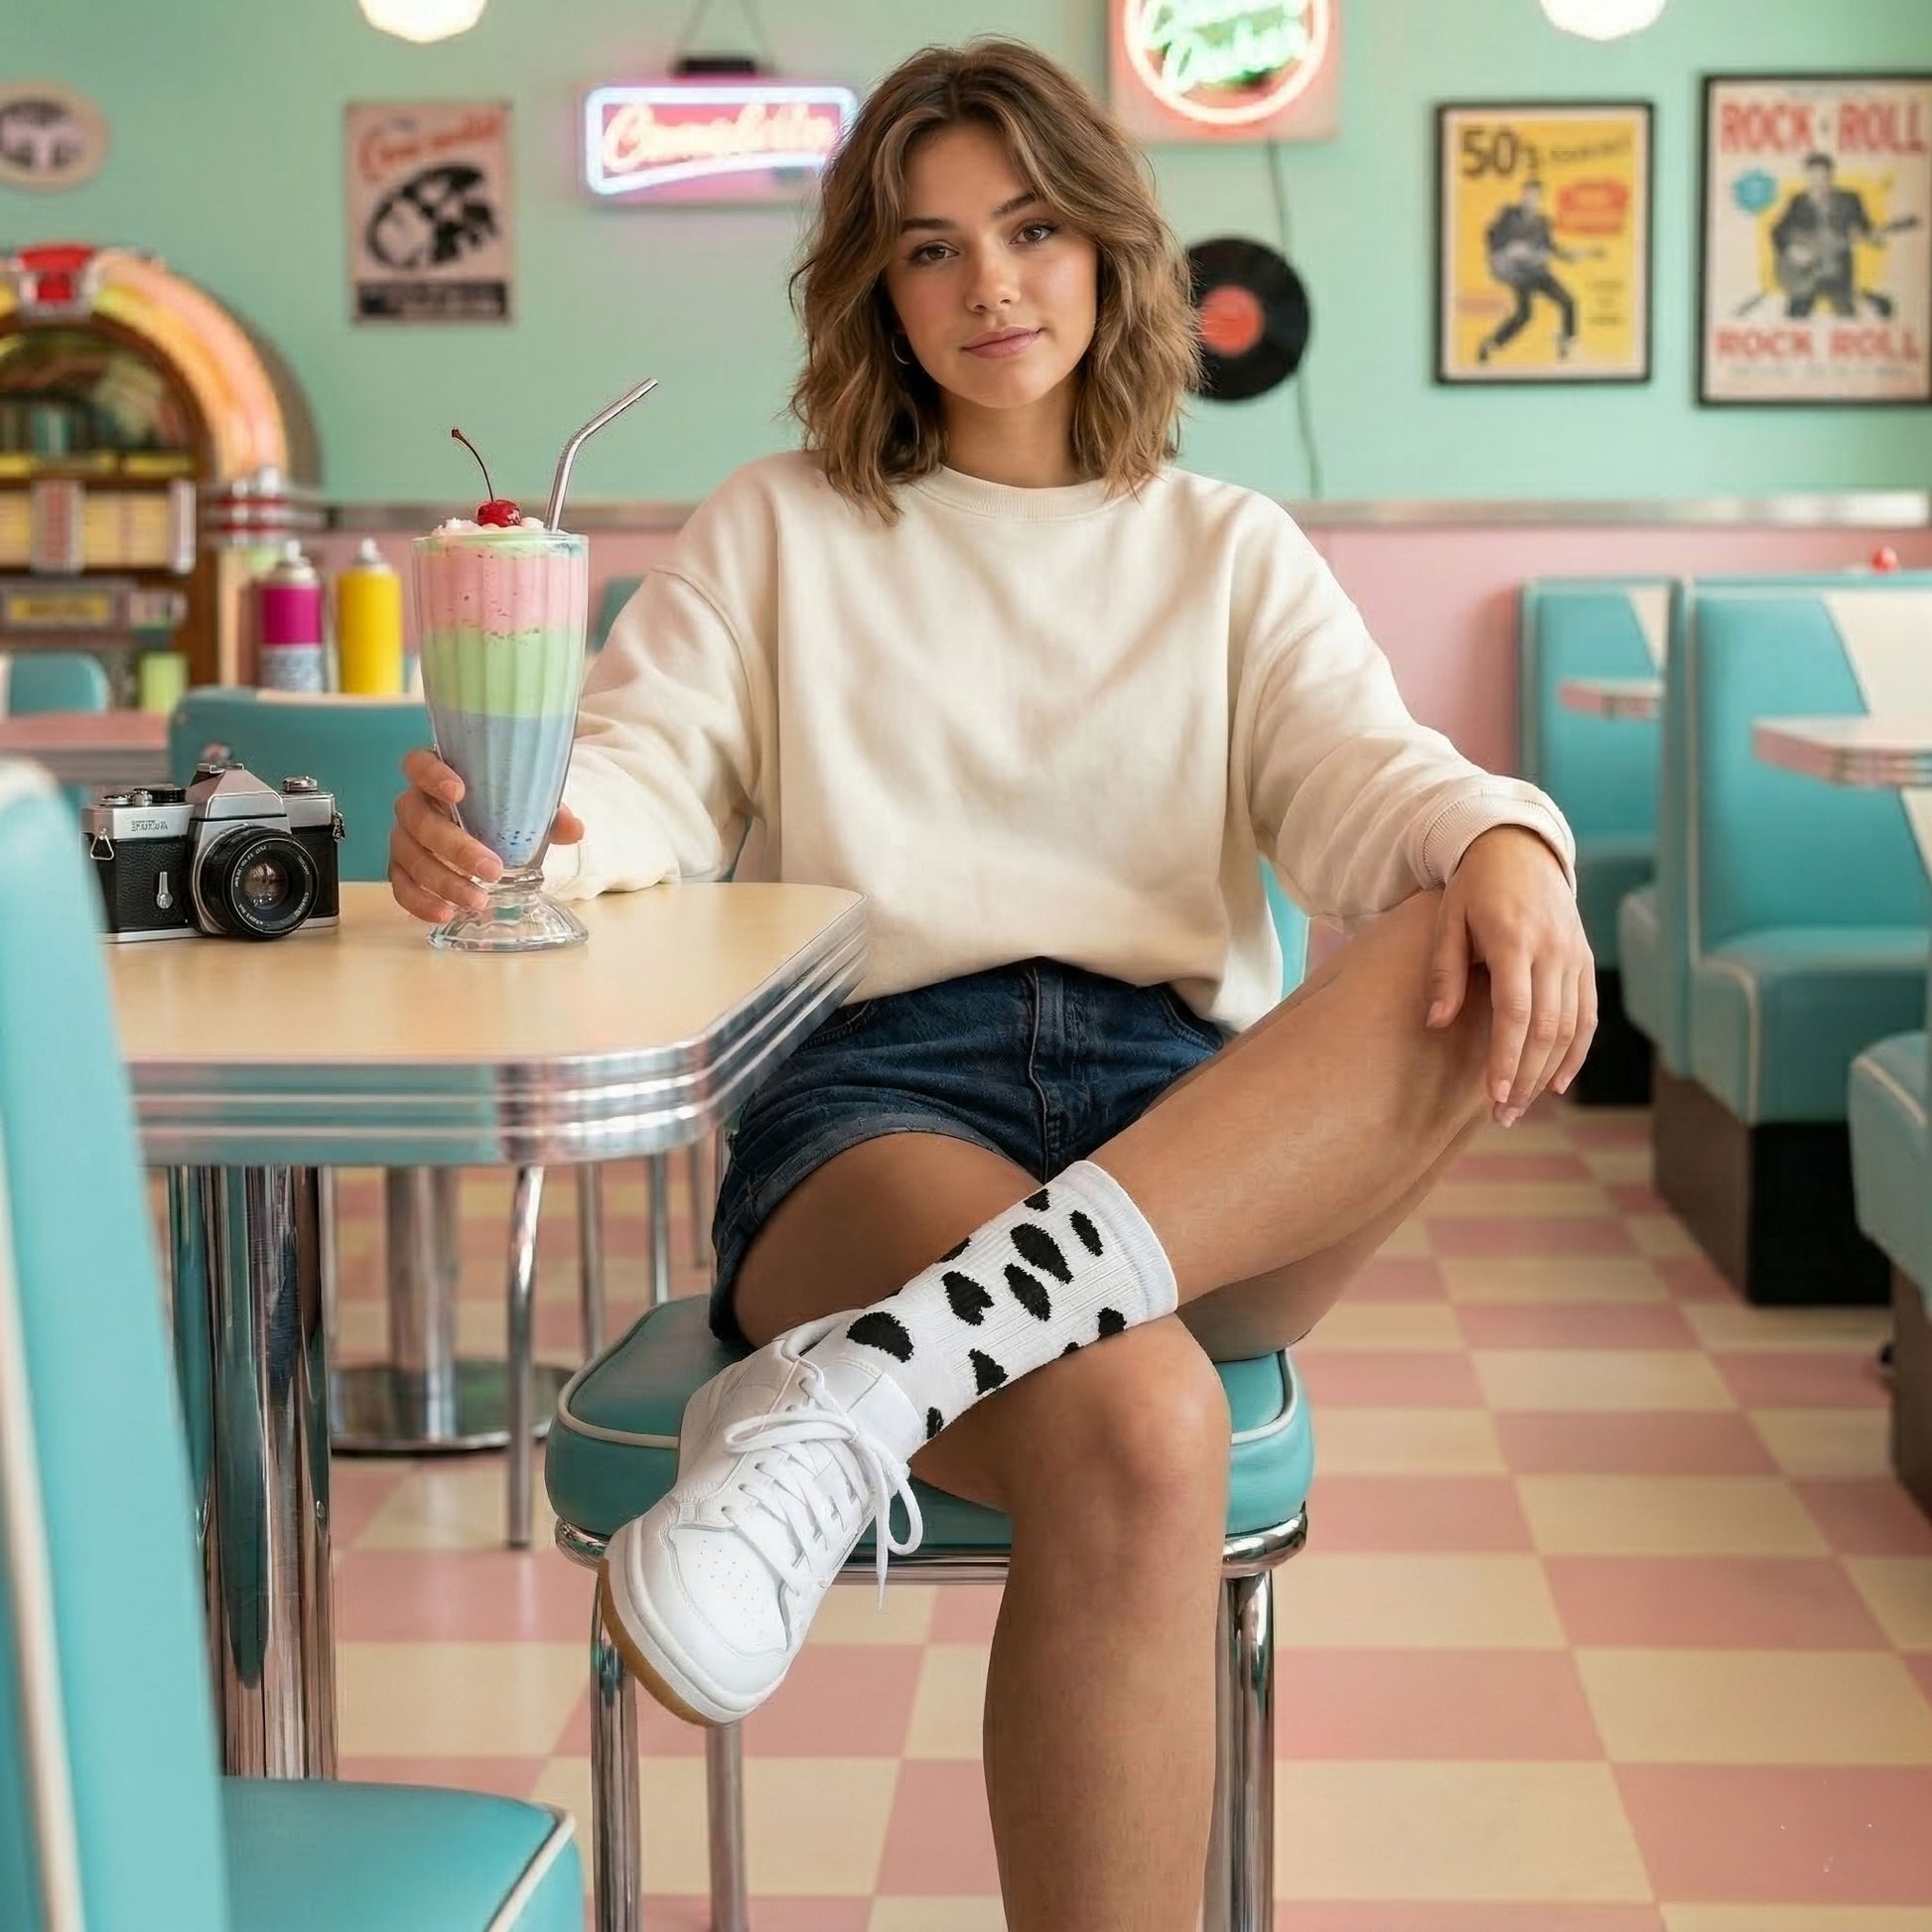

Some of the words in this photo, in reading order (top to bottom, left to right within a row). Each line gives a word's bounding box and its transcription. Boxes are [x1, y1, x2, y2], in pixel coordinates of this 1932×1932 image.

[1721, 103, 1814, 151] ROCK
[1838, 103, 1924, 155] ROLL
[1717, 328, 1812, 359] ROCK
[1831, 328, 1921, 362] ROLL
